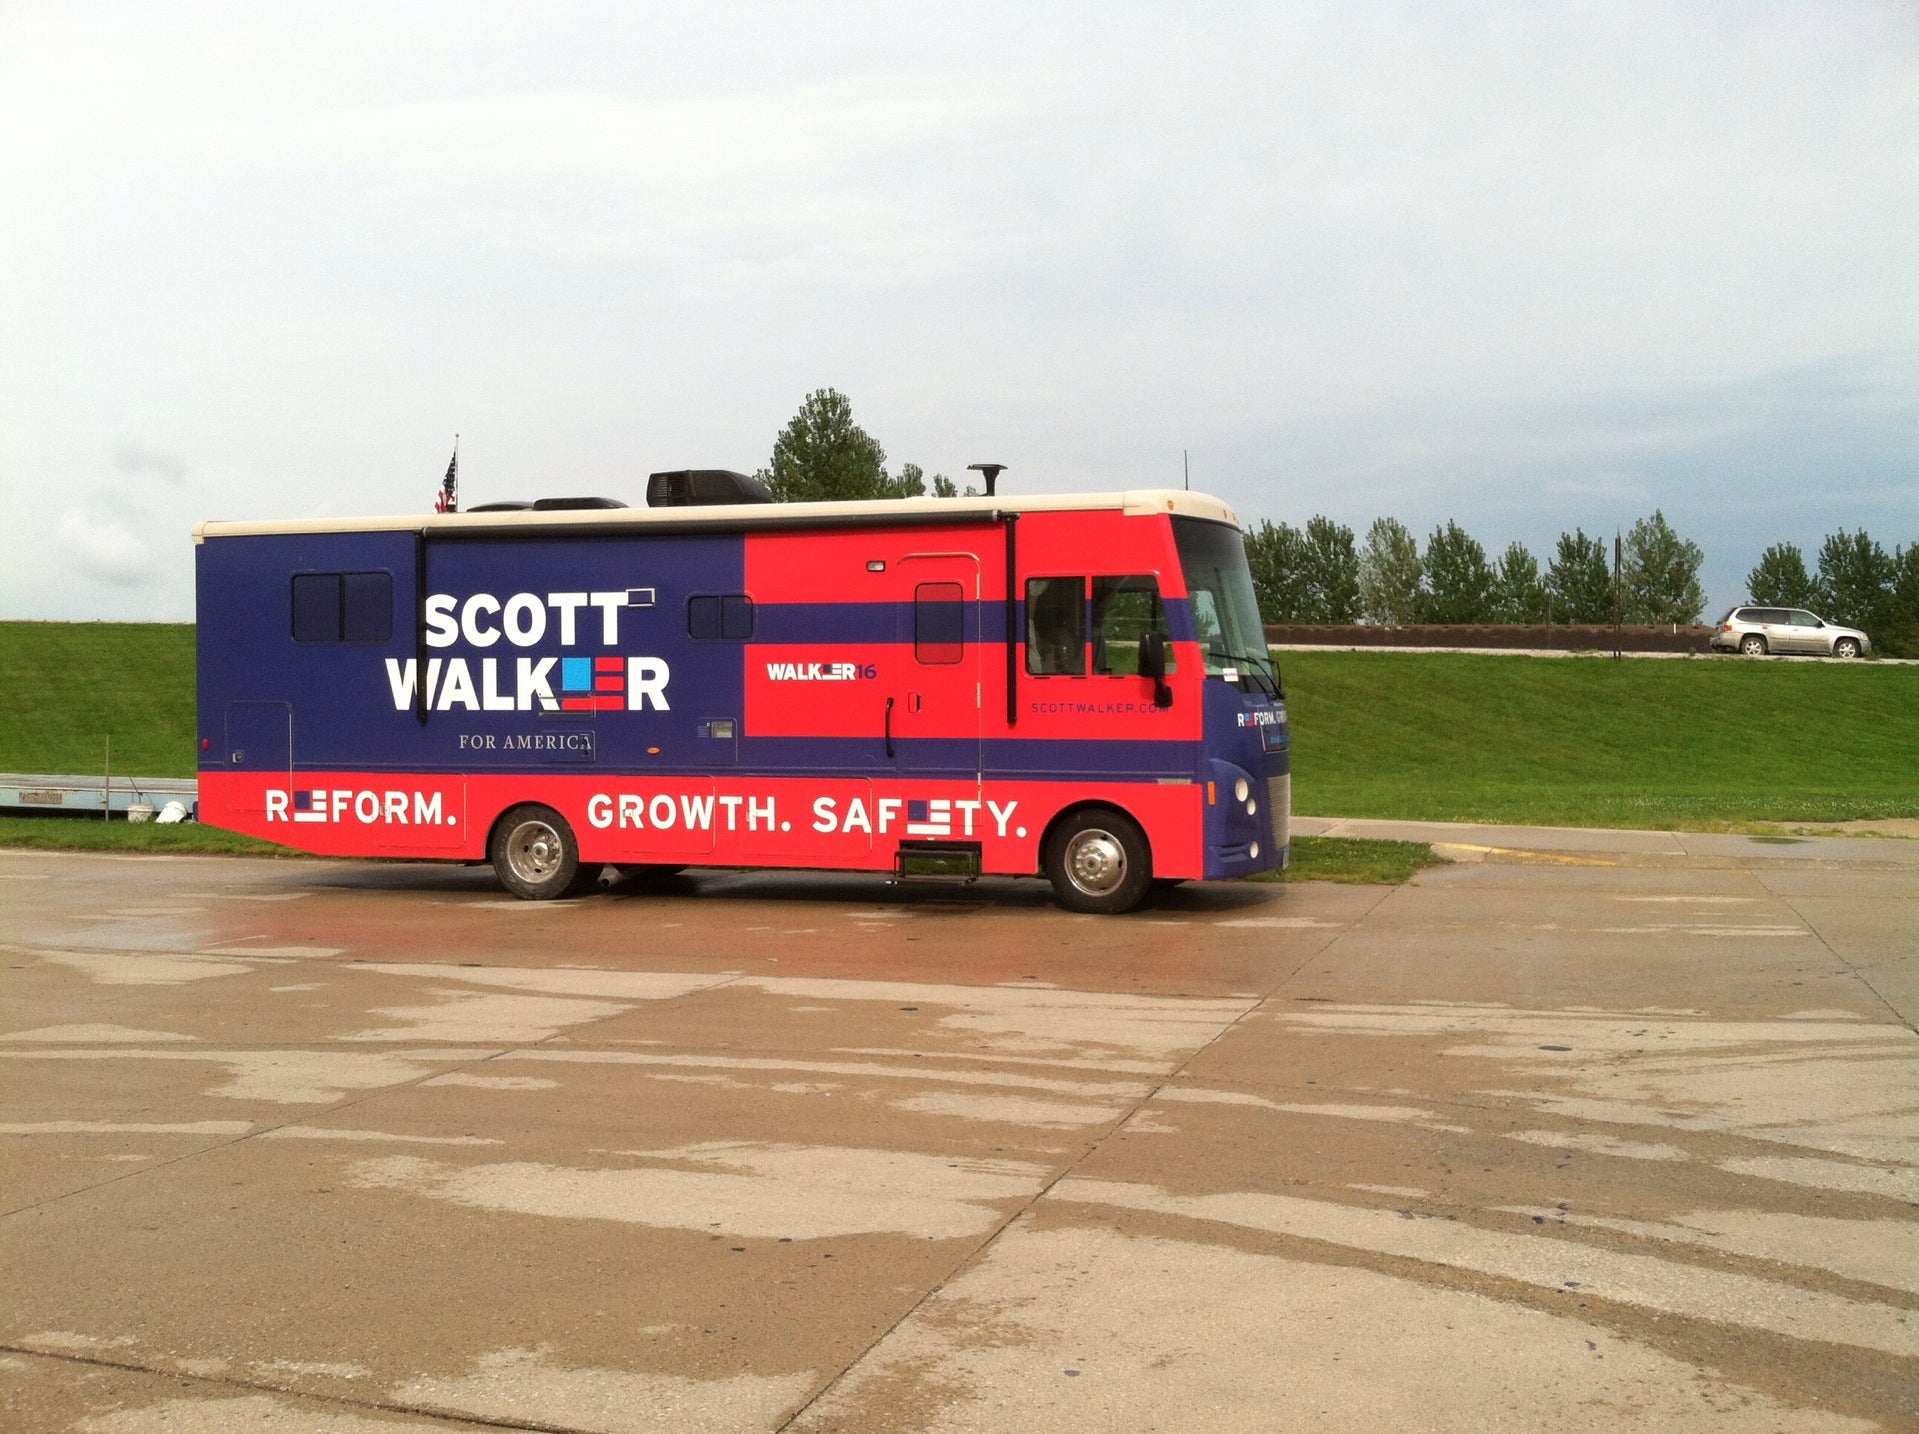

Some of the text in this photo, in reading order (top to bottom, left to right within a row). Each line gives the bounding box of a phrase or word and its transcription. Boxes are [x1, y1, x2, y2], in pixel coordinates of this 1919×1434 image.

[425, 592, 629, 647] SCOTT
[385, 657, 671, 711] WALKER
[459, 735, 592, 750] FOR AMERICA
[265, 789, 1028, 838] REFORM. GROWTH. SAFETY.
